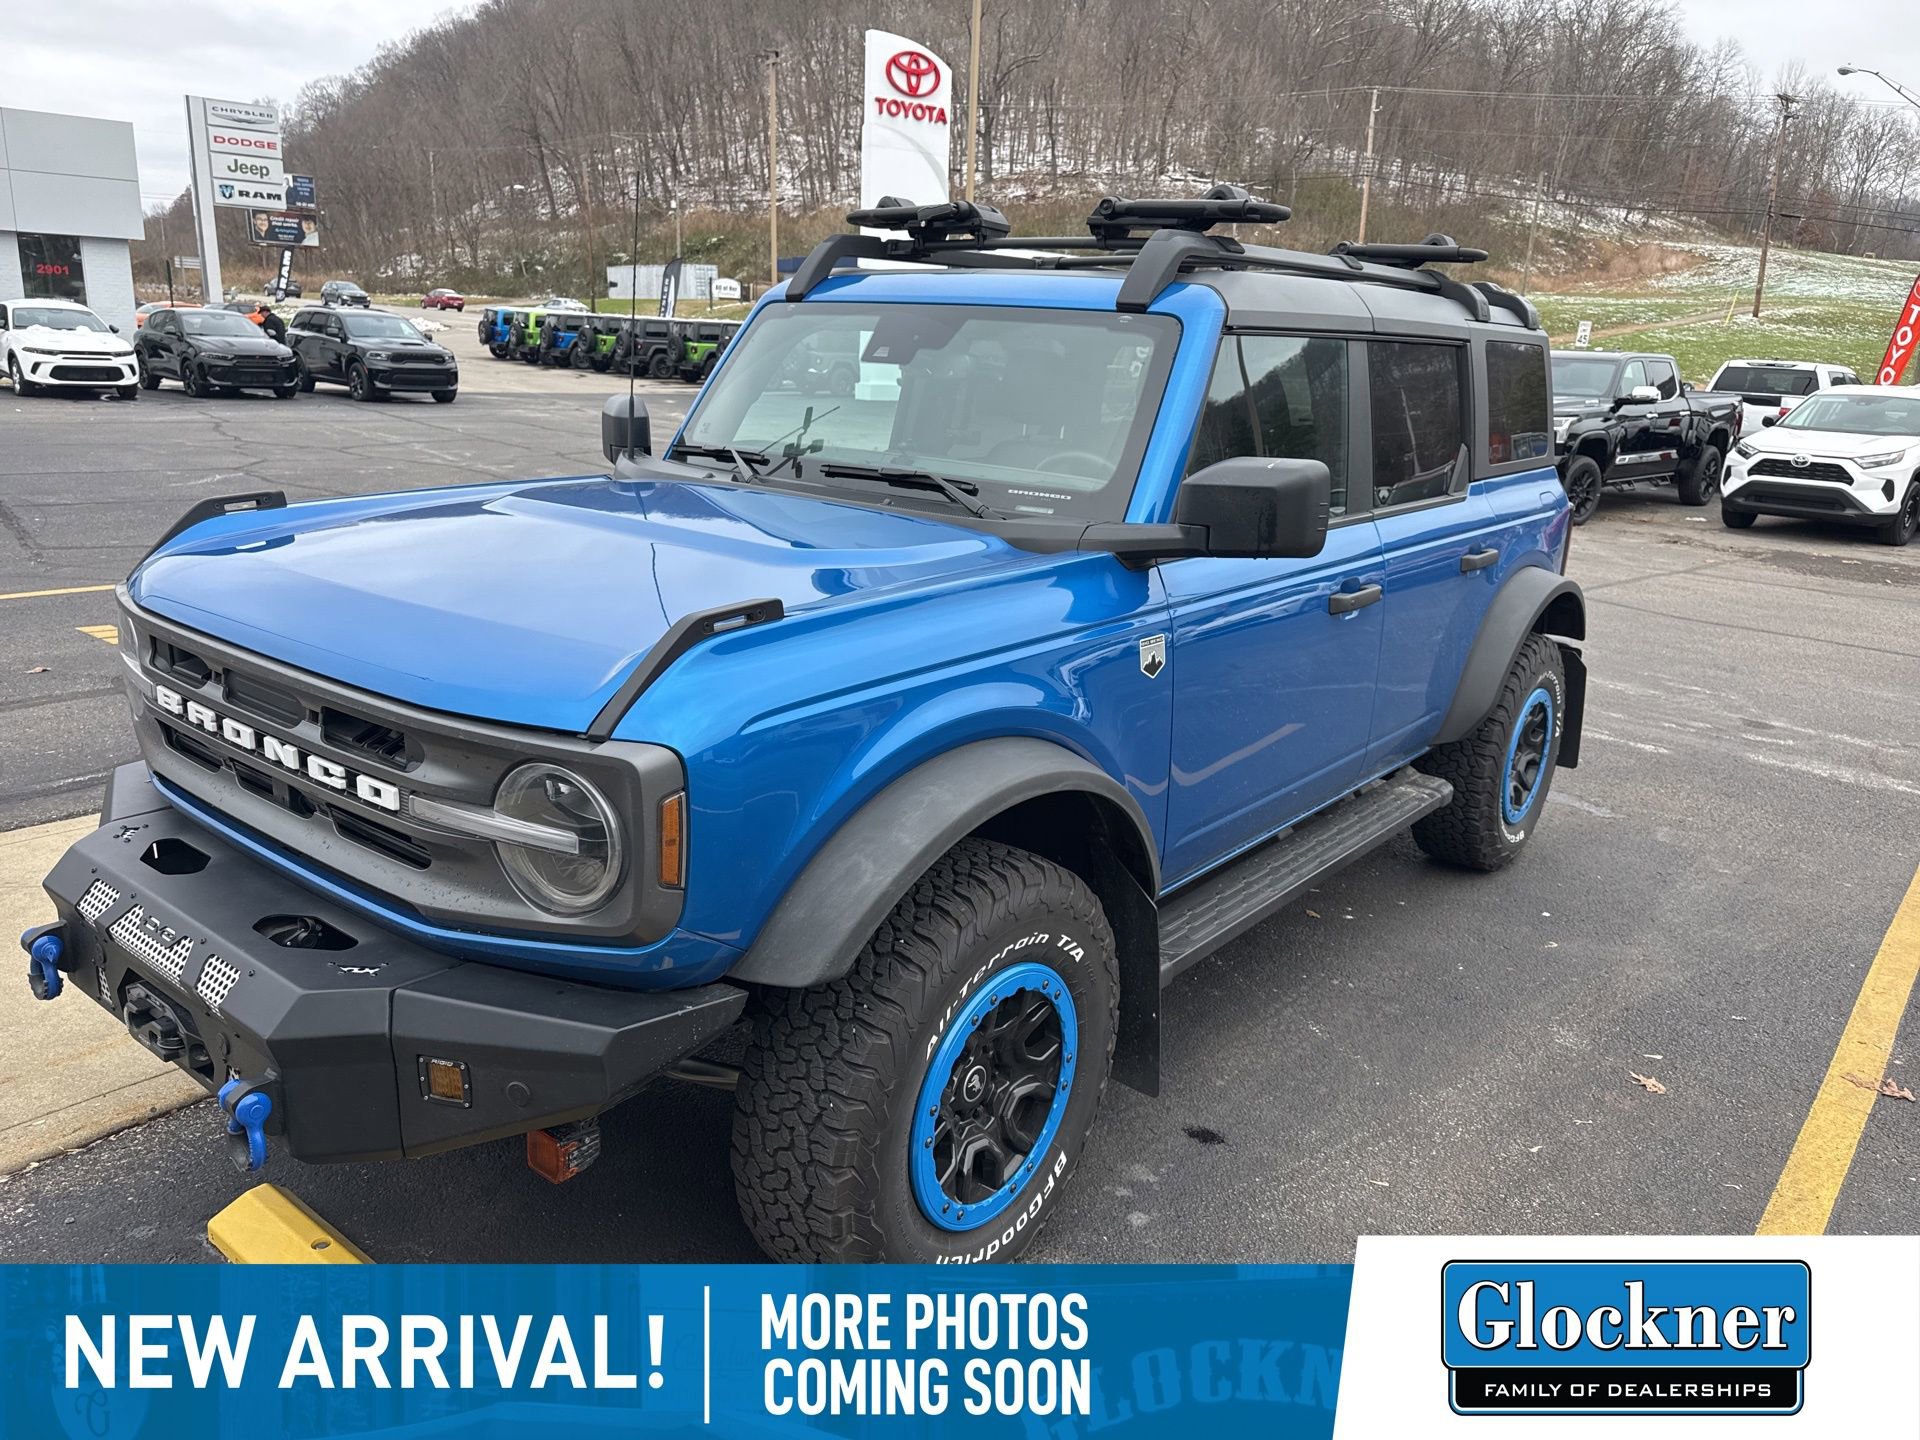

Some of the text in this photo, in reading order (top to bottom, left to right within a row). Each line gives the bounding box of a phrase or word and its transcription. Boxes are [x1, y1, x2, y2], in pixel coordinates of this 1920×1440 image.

[211, 106, 273, 119] CHRYSLER
[874, 97, 948, 126] TOYOTA
[213, 135, 278, 151] DODGE
[227, 158, 270, 179] Jeep
[238, 190, 282, 201] RAM
[36, 264, 69, 276] 2901
[279, 250, 292, 289] RAM
[1577, 334, 1588, 345] 45
[1008, 489, 1072, 500] BRONCO
[156, 685, 400, 811] BRONCO
[926, 932, 1085, 1060] All-Terrain T/A
